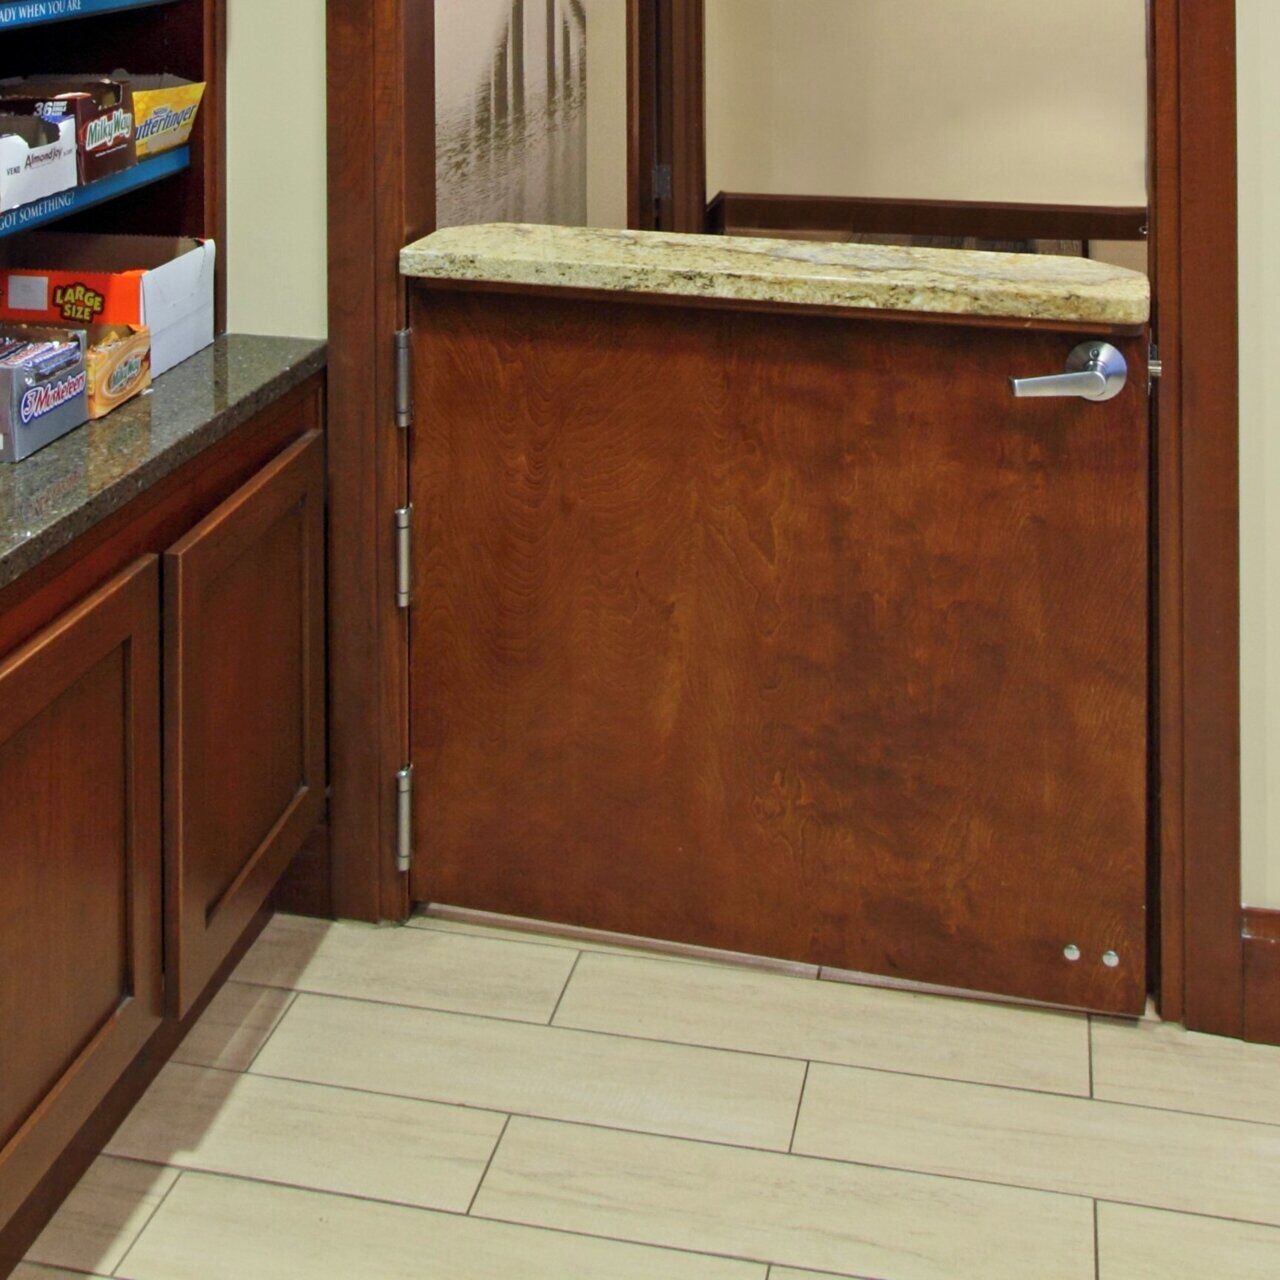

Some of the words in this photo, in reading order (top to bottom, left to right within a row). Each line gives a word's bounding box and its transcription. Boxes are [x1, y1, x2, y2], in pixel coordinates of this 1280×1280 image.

[18, 0, 47, 21] WHEN
[33, 100, 51, 118] 36
[18, 191, 76, 226] SOMETHING?
[55, 284, 104, 312] LARGE
[63, 304, 93, 322] SIZE
